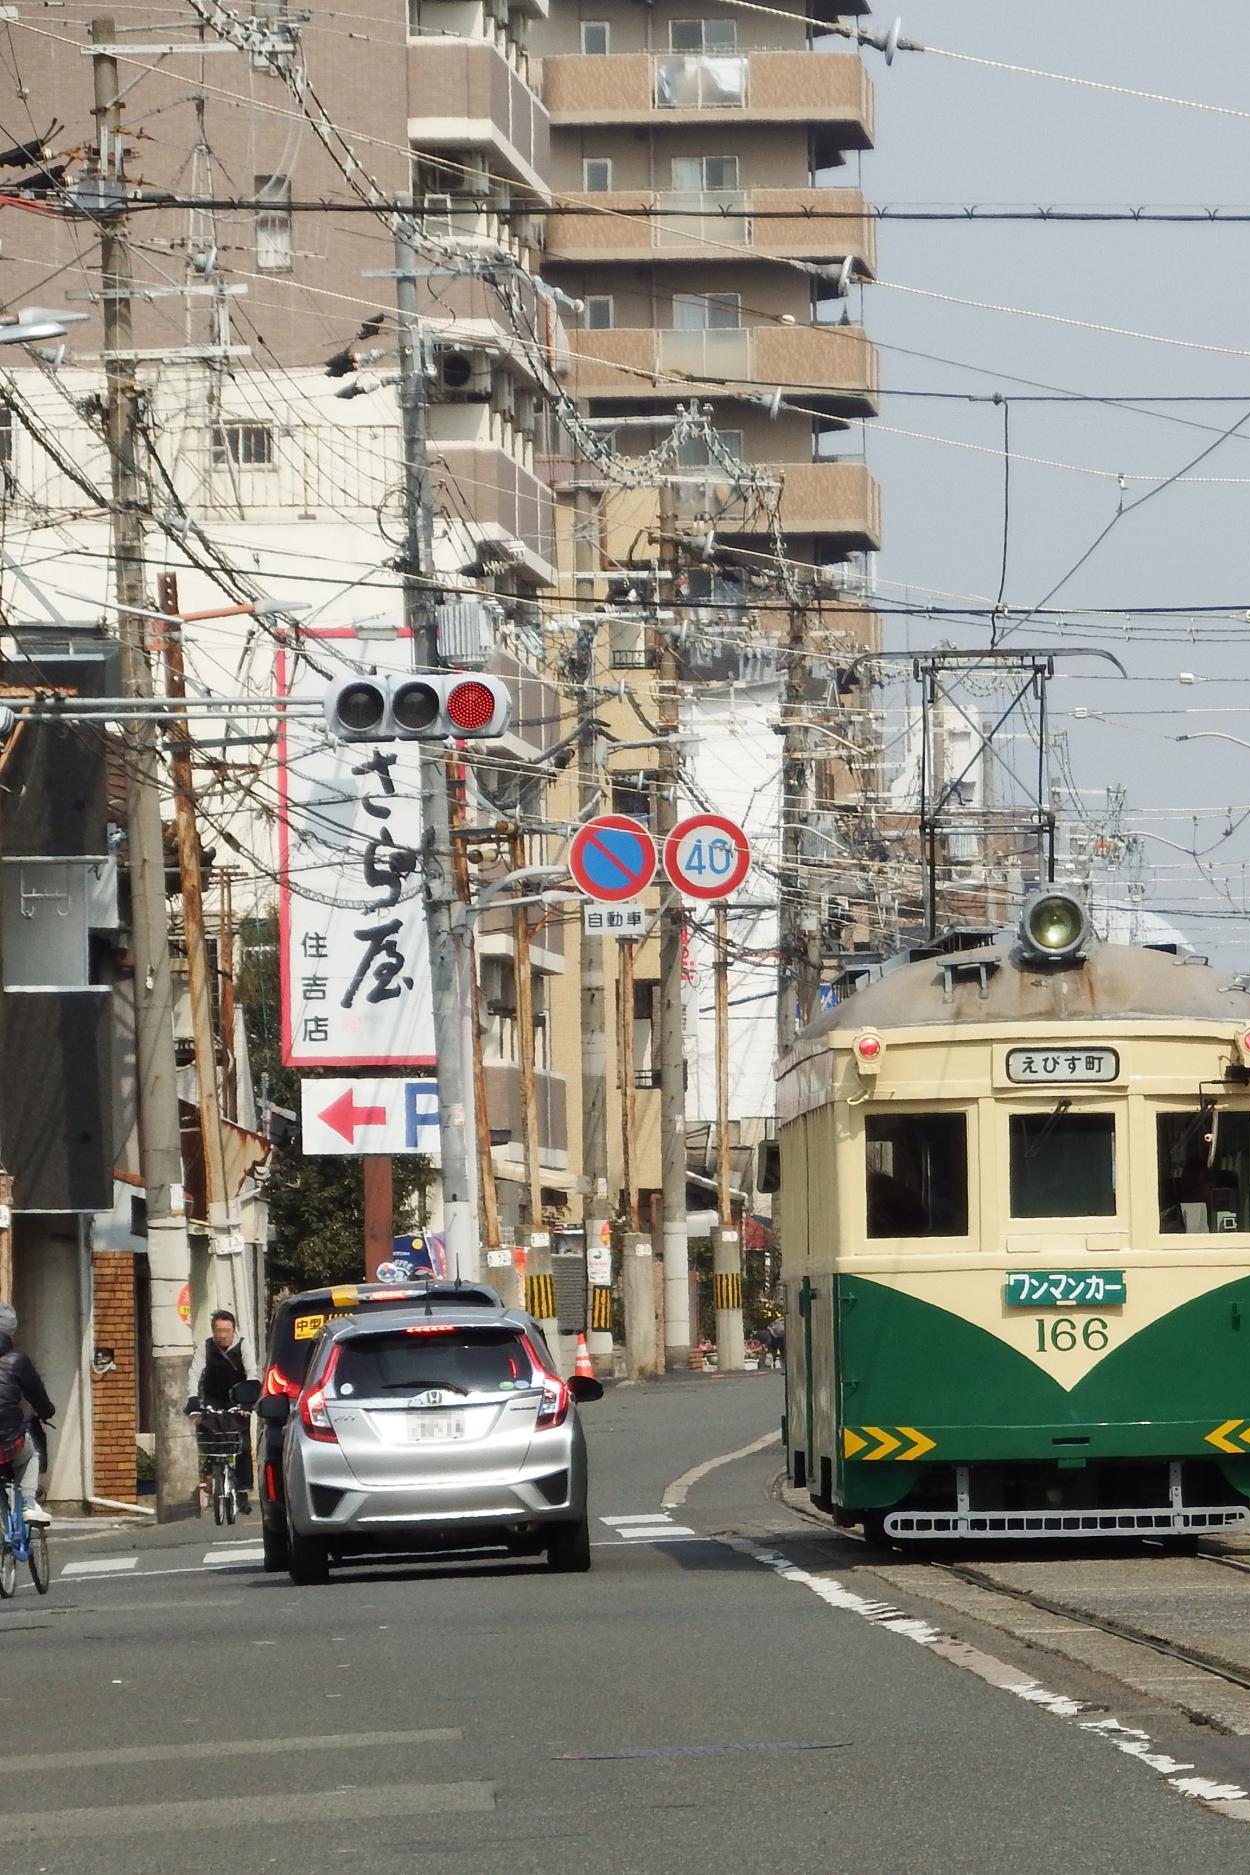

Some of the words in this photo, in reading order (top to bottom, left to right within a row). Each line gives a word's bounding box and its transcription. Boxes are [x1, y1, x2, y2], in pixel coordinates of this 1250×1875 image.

[685, 838, 731, 875] 40
[588, 911, 641, 928] 自動車
[300, 931, 329, 1042] 住吉店
[1021, 1055, 1104, 1074] えびす町
[405, 1083, 439, 1147] P
[1009, 1273, 1122, 1301] ワンマンカー
[296, 1318, 322, 1333] 中型
[1035, 1317, 1109, 1353] 166
